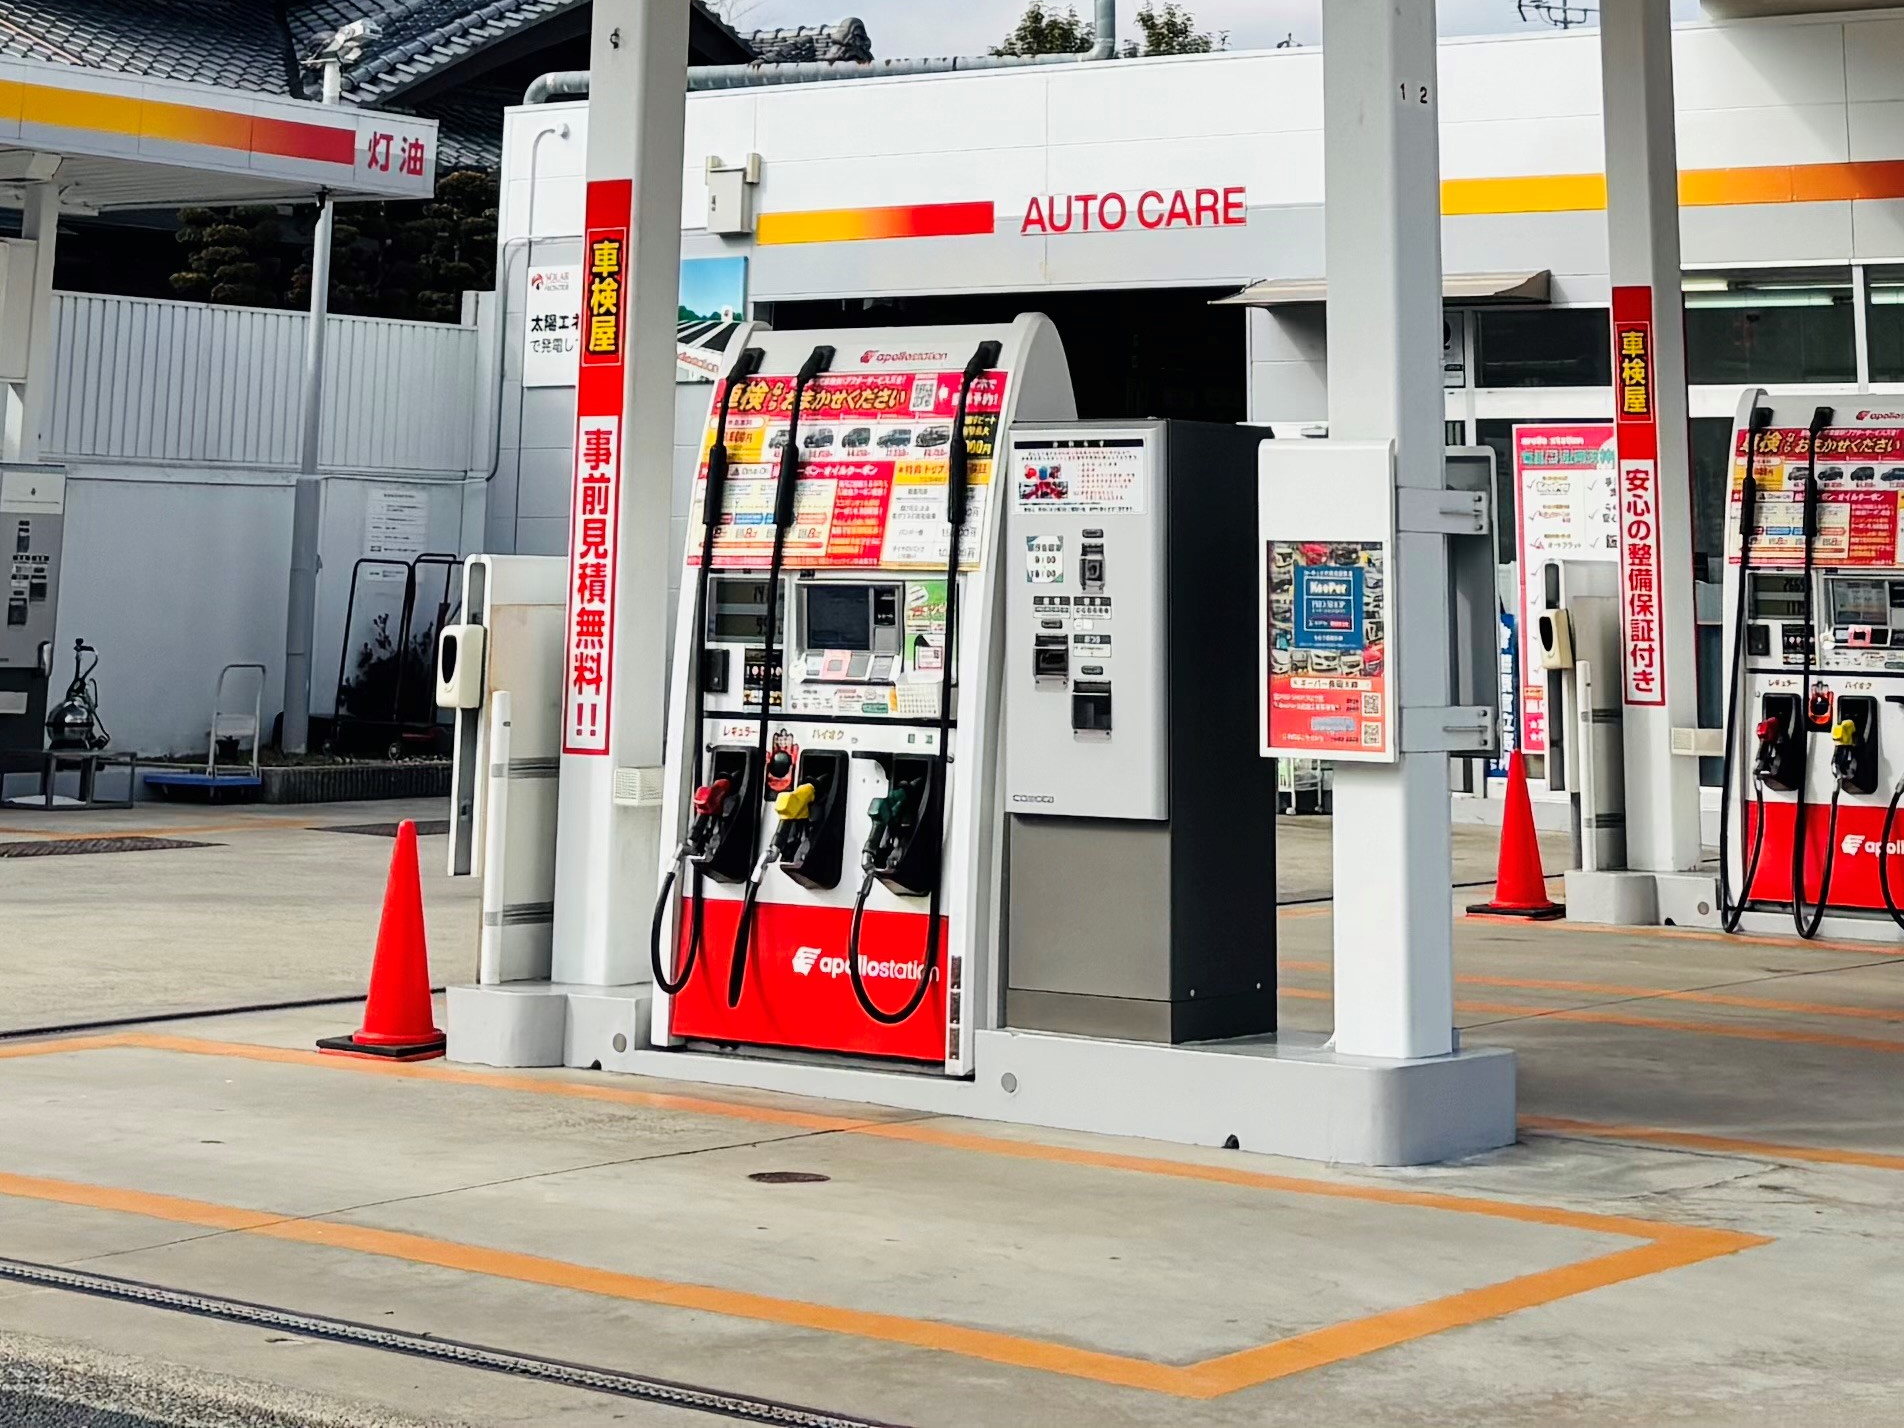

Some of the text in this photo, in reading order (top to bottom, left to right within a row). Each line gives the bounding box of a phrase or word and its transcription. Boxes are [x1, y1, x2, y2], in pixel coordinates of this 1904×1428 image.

[368, 130, 424, 176] 灯油
[1021, 186, 1247, 233] AUTO CARE
[589, 240, 620, 352] 車検屋
[876, 350, 948, 363] apollostation
[1621, 330, 1648, 414] 車検屋
[573, 428, 612, 737] 事前見積無料!!
[1624, 467, 1656, 694] 安心の整備保証付き
[723, 726, 759, 737] レギュラー
[812, 729, 845, 741] ハイオク
